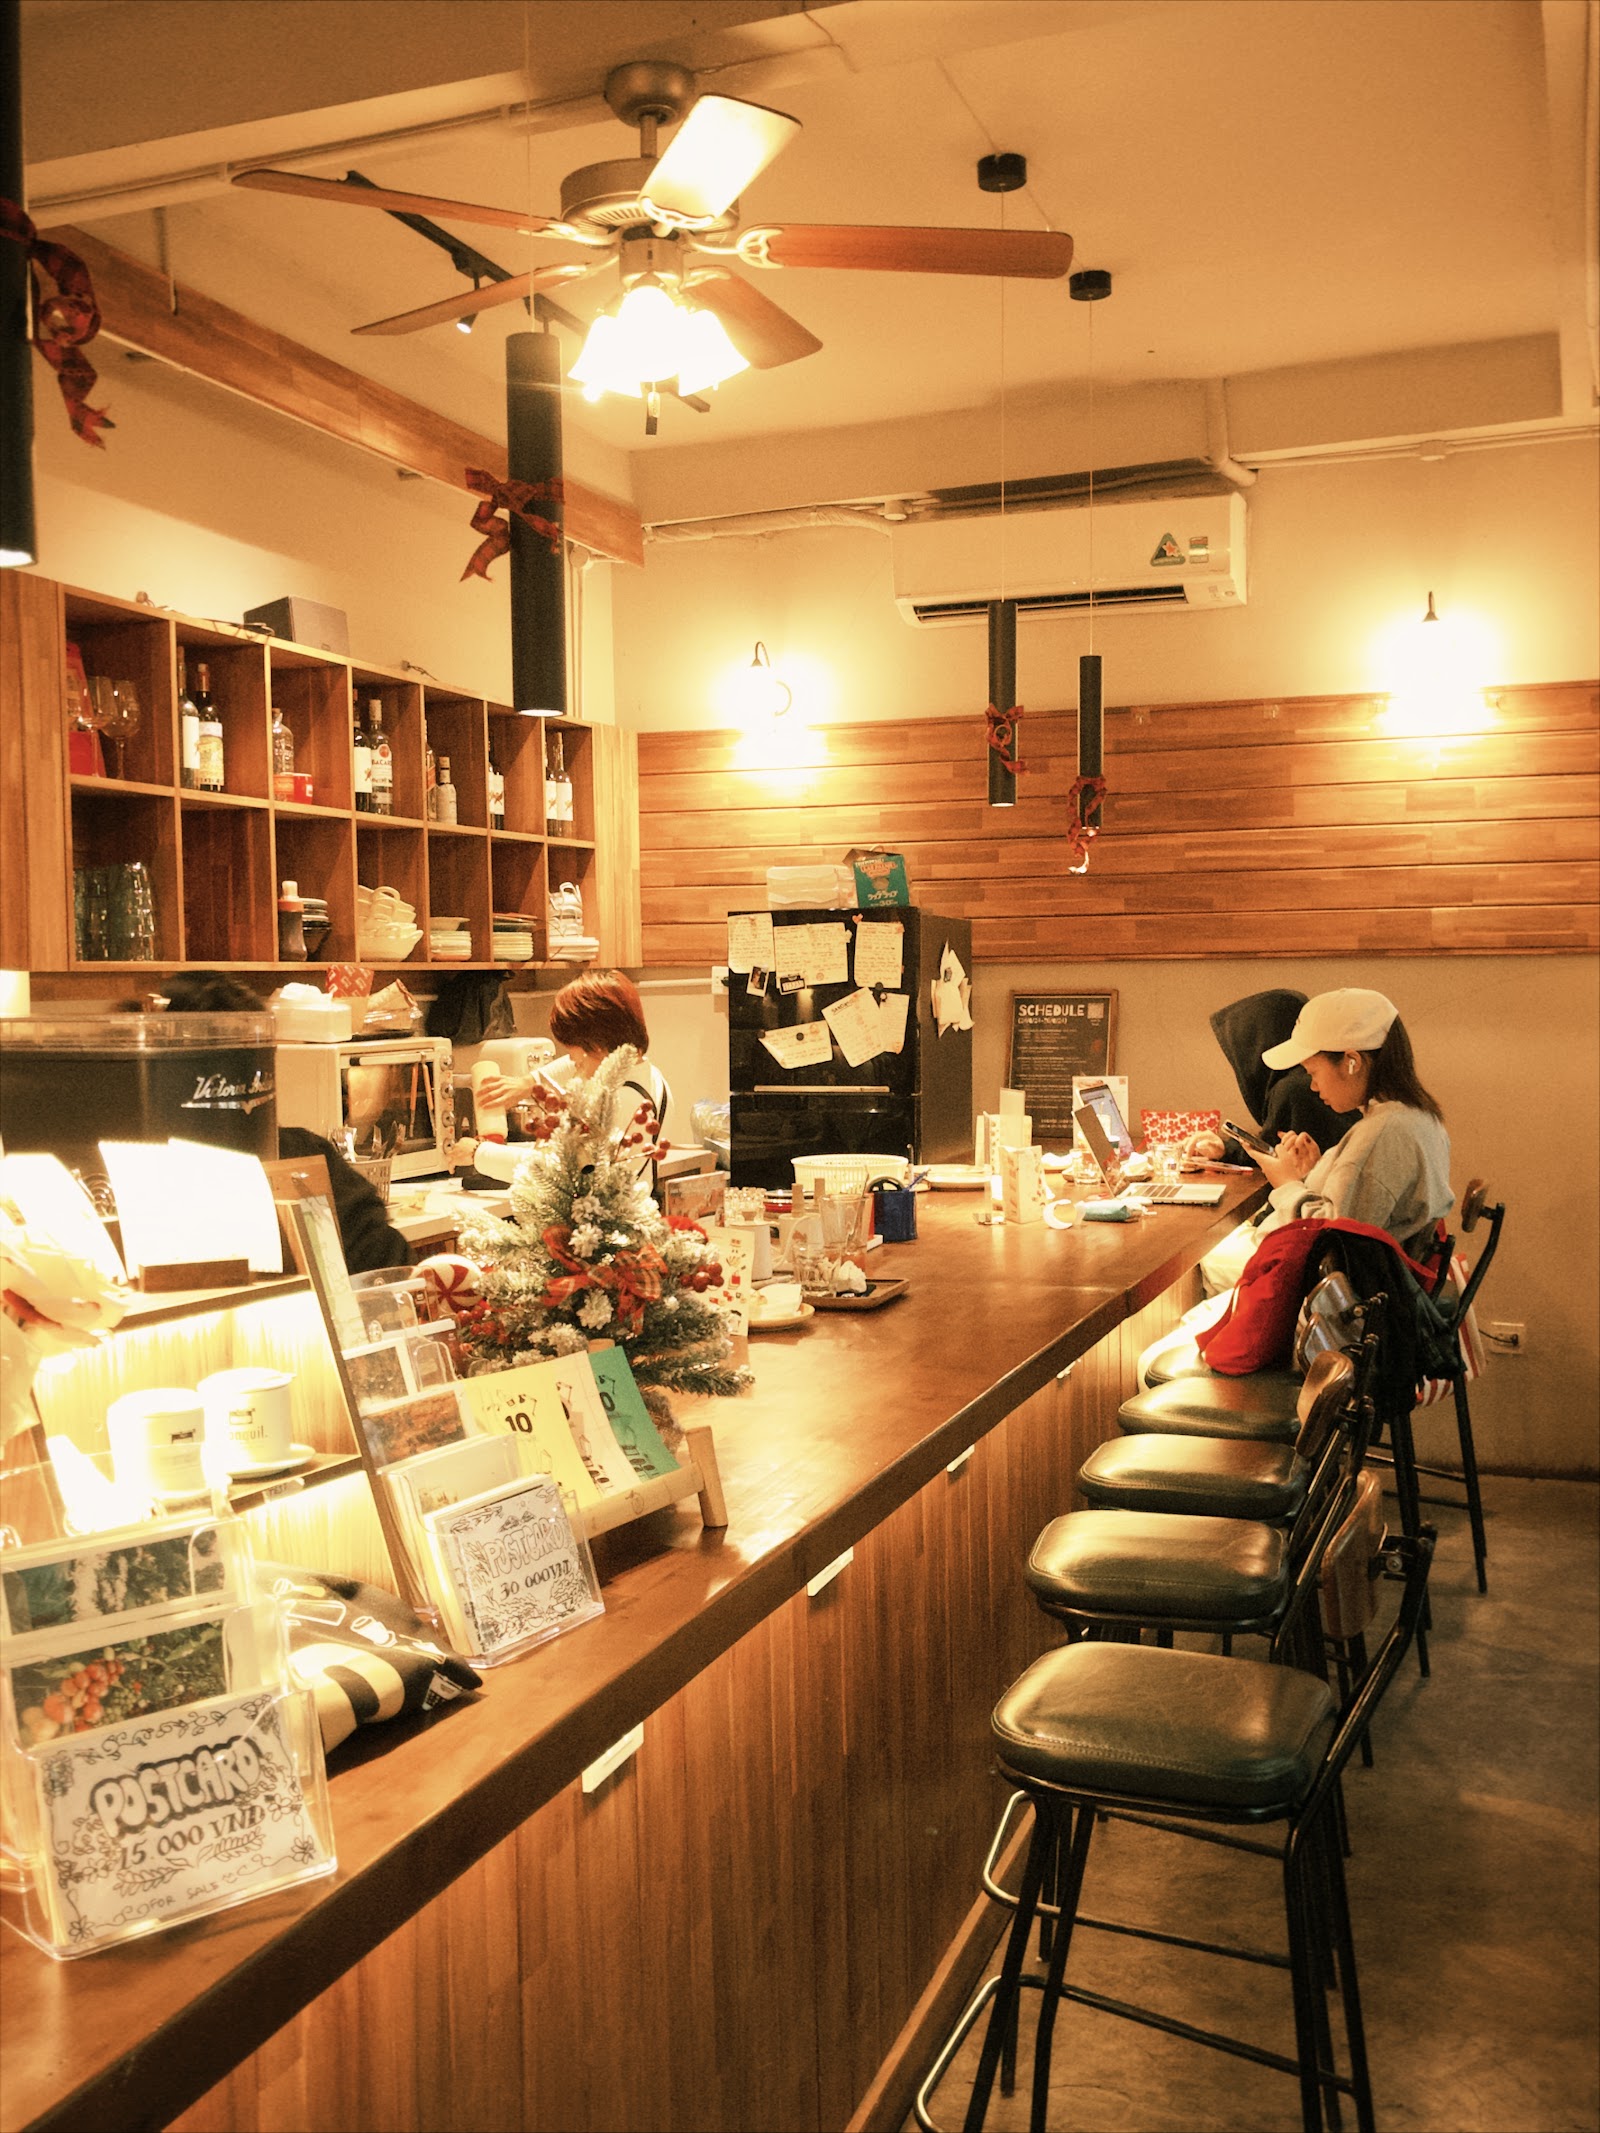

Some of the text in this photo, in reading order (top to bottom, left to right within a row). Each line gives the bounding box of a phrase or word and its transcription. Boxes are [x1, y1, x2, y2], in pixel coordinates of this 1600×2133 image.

[1018, 1003, 1085, 1017] SCHEDULE
[504, 1412, 533, 1434] 10
[482, 1516, 565, 1579] POSTCARD
[90, 1736, 264, 1840] POSTCARD
[150, 1881, 219, 1909] FOR SALE
